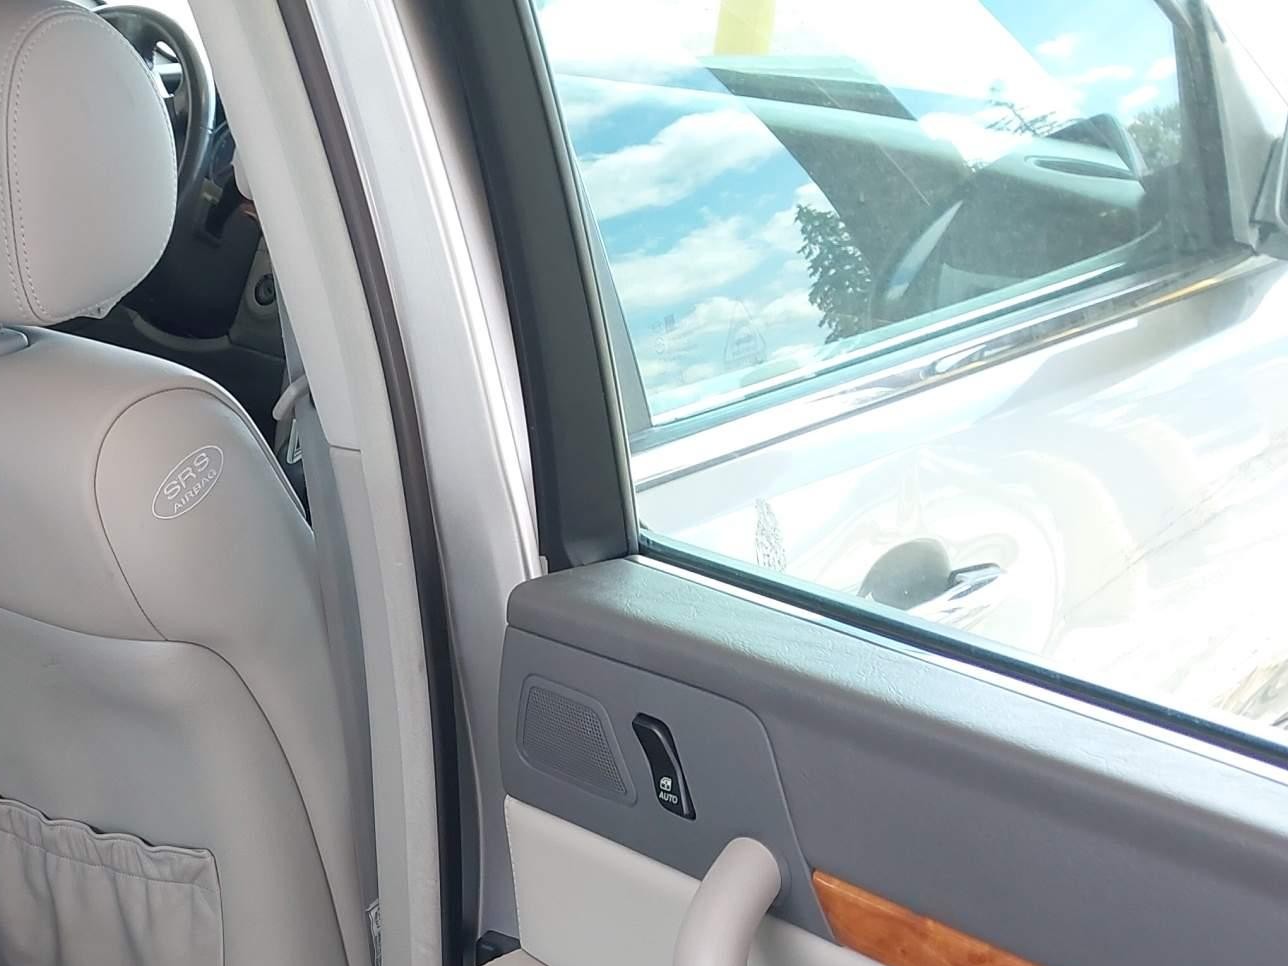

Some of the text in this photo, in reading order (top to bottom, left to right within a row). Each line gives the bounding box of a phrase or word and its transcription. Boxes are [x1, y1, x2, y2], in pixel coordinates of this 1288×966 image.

[163, 452, 210, 500] SRS
[174, 468, 217, 513] AIRBAG
[658, 790, 679, 804] AUTO
